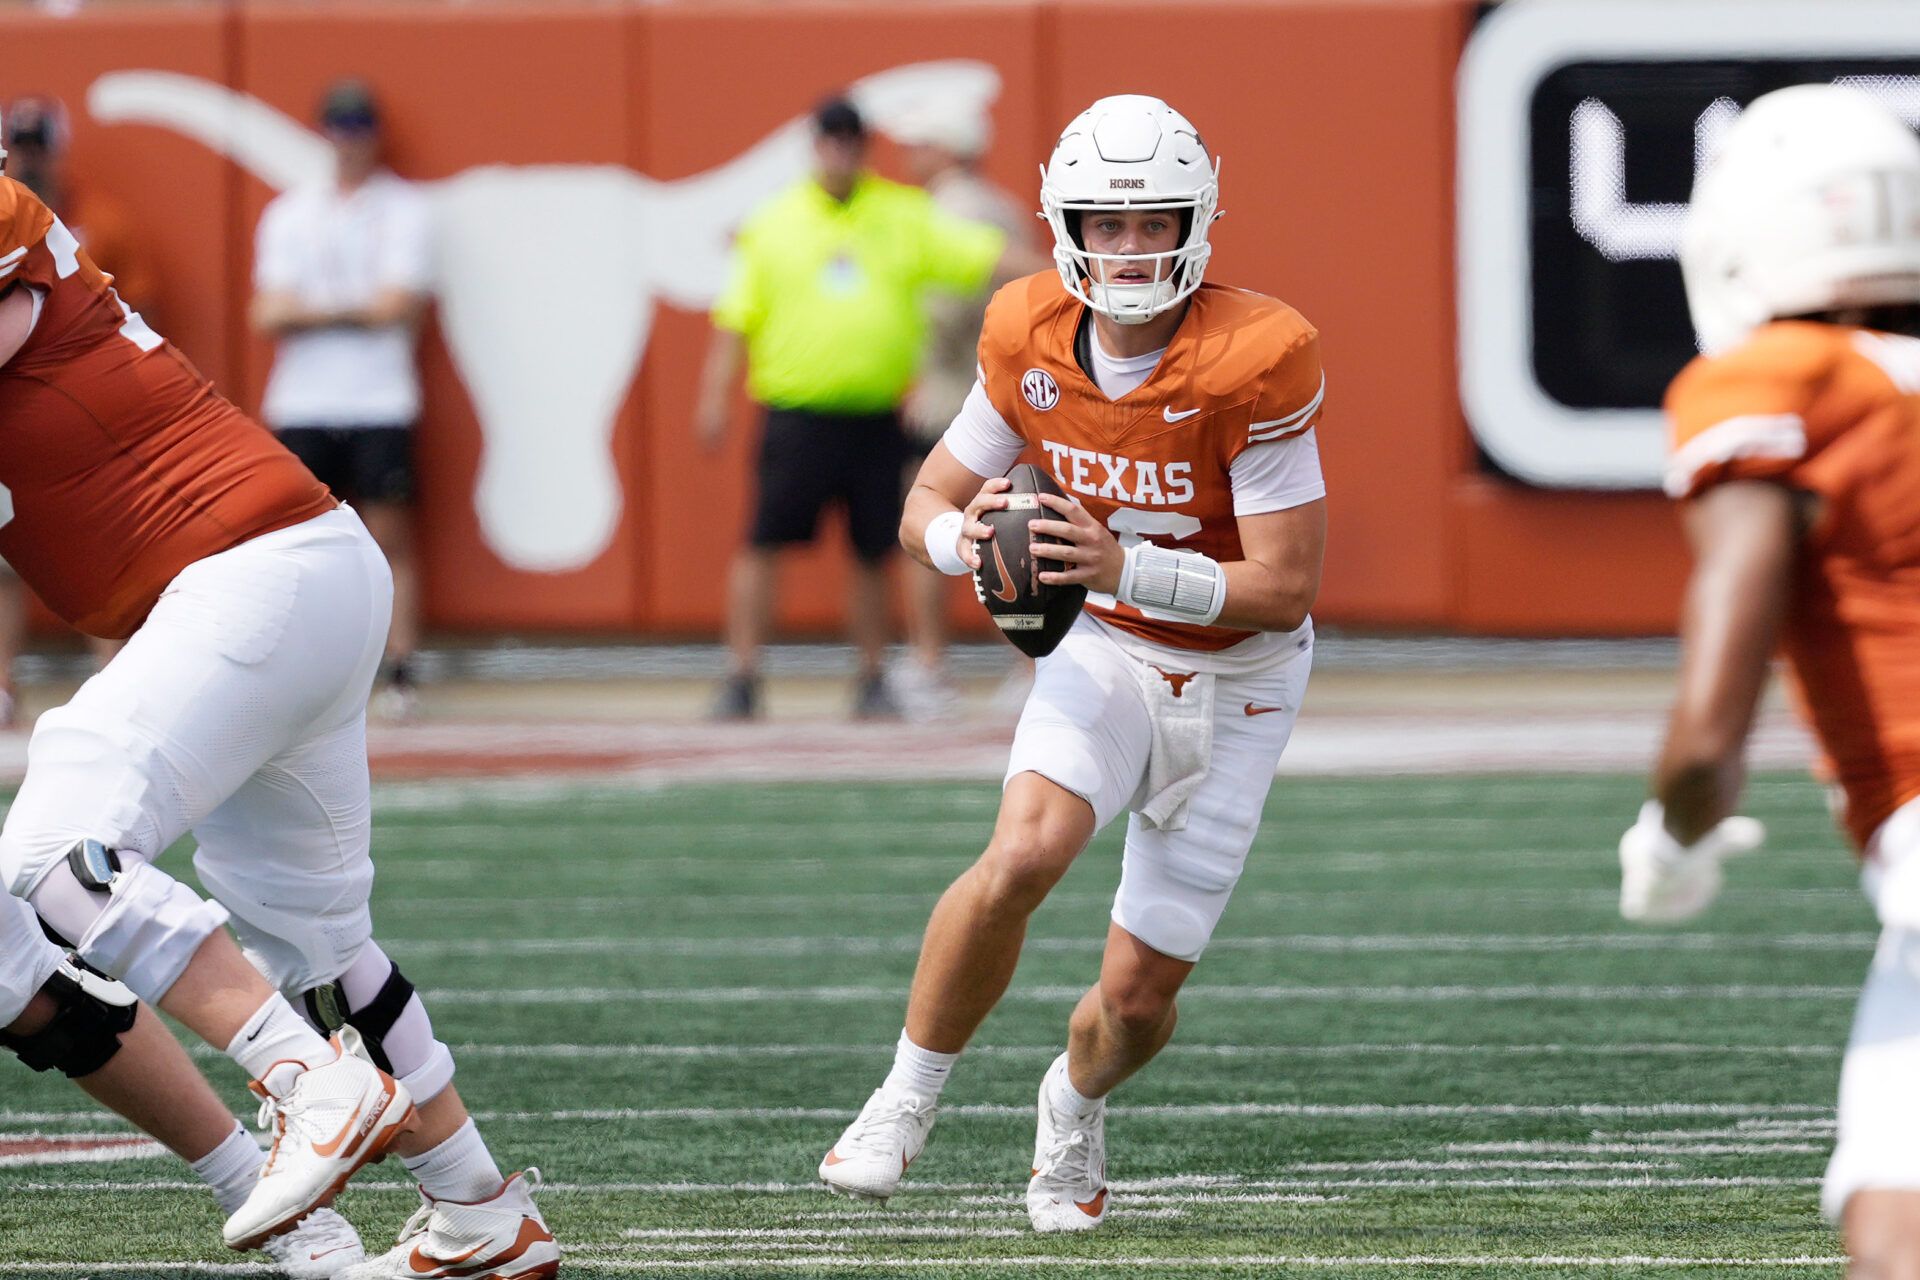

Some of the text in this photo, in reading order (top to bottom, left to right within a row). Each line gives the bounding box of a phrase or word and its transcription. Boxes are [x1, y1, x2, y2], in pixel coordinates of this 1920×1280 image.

[1109, 178, 1145, 189] HORNS
[1024, 371, 1057, 408] SEC
[1041, 439, 1195, 505] TEXAS
